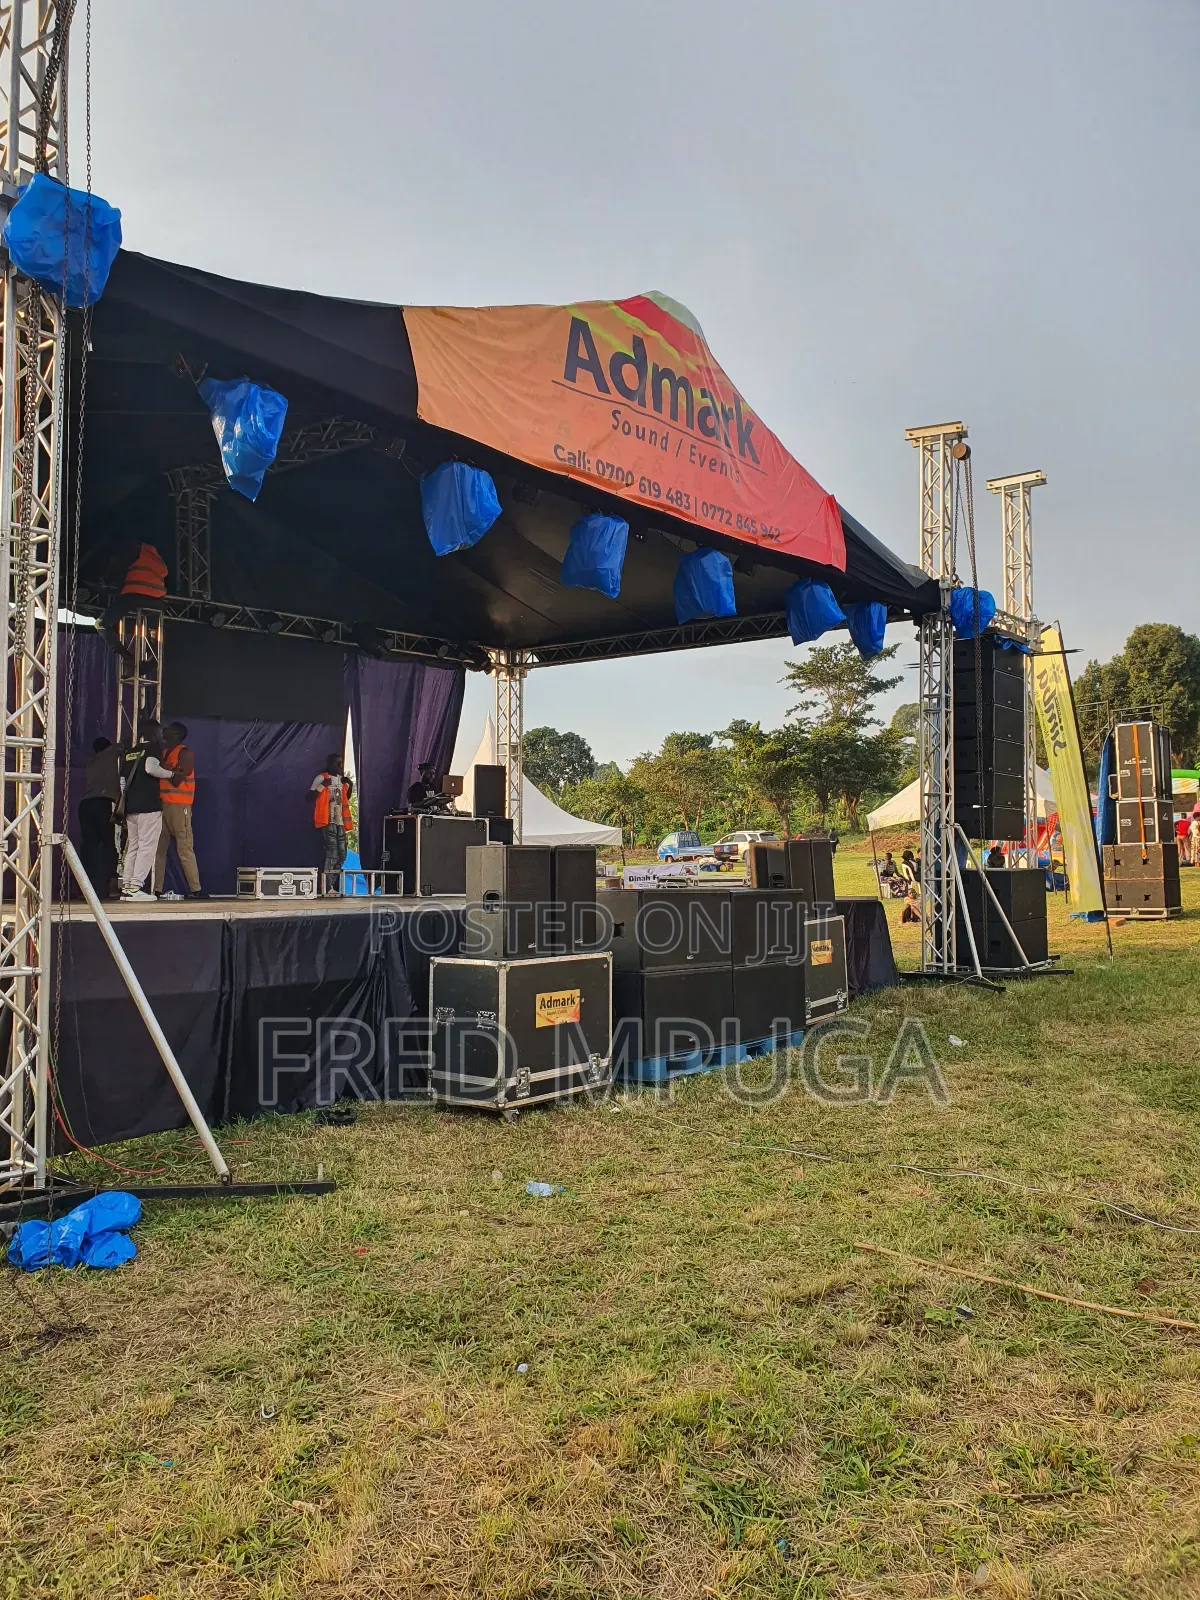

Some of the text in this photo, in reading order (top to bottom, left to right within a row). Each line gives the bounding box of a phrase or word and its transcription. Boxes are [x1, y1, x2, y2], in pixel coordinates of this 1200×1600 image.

[564, 316, 760, 464] Admark
[611, 409, 669, 452] Sound
[689, 444, 740, 485] Events
[553, 443, 591, 473] Call:
[596, 459, 635, 487] 0700
[638, 476, 662, 498] 619
[665, 487, 691, 511] 483
[701, 500, 732, 526] 0772
[736, 514, 758, 535] 845
[760, 523, 781, 542] 942
[540, 994, 576, 1009] Admark
